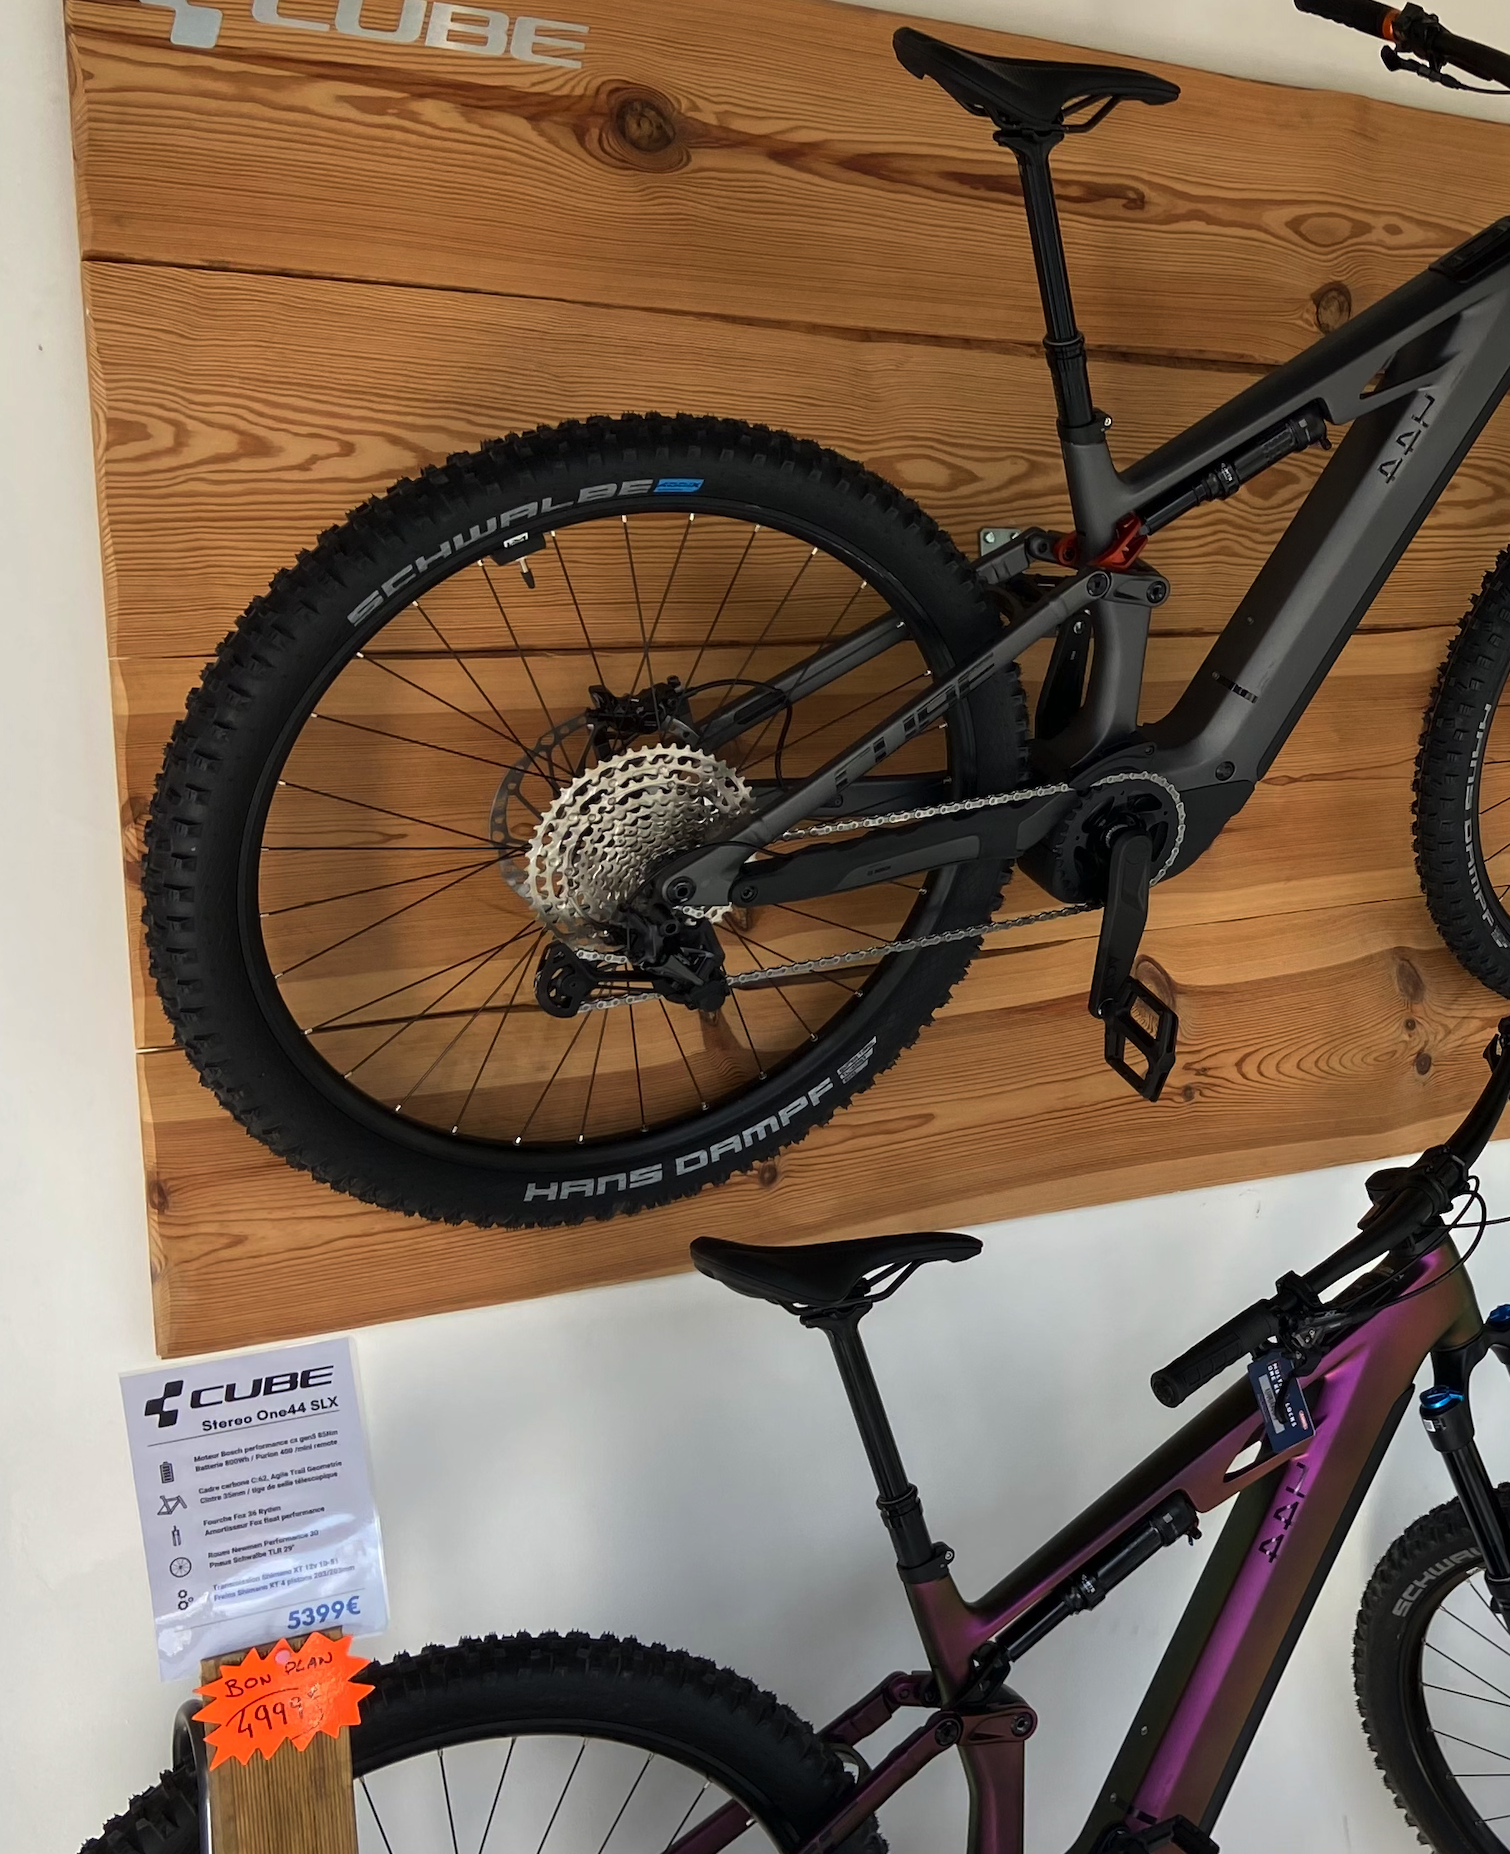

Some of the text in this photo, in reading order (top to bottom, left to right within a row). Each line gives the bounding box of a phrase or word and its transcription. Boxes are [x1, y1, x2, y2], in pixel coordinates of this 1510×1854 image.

[251, 0, 590, 68] CUBE
[347, 479, 654, 627] SCHWALBE
[1464, 817, 1494, 926] DAMPF
[524, 1077, 834, 1201] HANS DAMPF
[190, 1365, 334, 1409] CUBE
[202, 1396, 339, 1431] Stereo One44 SLX
[194, 1452, 220, 1462] Moteur
[220, 1448, 243, 1457] Bosch
[244, 1439, 289, 1453] performance
[195, 1461, 224, 1471] Batterie
[313, 1439, 337, 1448] remote
[198, 1485, 220, 1493] Cadre
[221, 1479, 250, 1489] carbone
[270, 1471, 289, 1480] Agile
[200, 1495, 222, 1503] Cintre
[222, 1490, 246, 1499] 35mm
[251, 1486, 266, 1494] tige
[277, 1480, 294, 1488] selle
[203, 1515, 232, 1526] Fourche
[204, 1522, 249, 1535] Amortisseur
[281, 1506, 325, 1521] performance
[209, 1559, 232, 1568] Pneus
[233, 1551, 267, 1563] Schwalbe
[268, 1548, 283, 1556] TLR
[1392, 1547, 1484, 1617] SCHWAL
[287, 1596, 361, 1630] 5399€
[225, 1674, 272, 1698] BON
